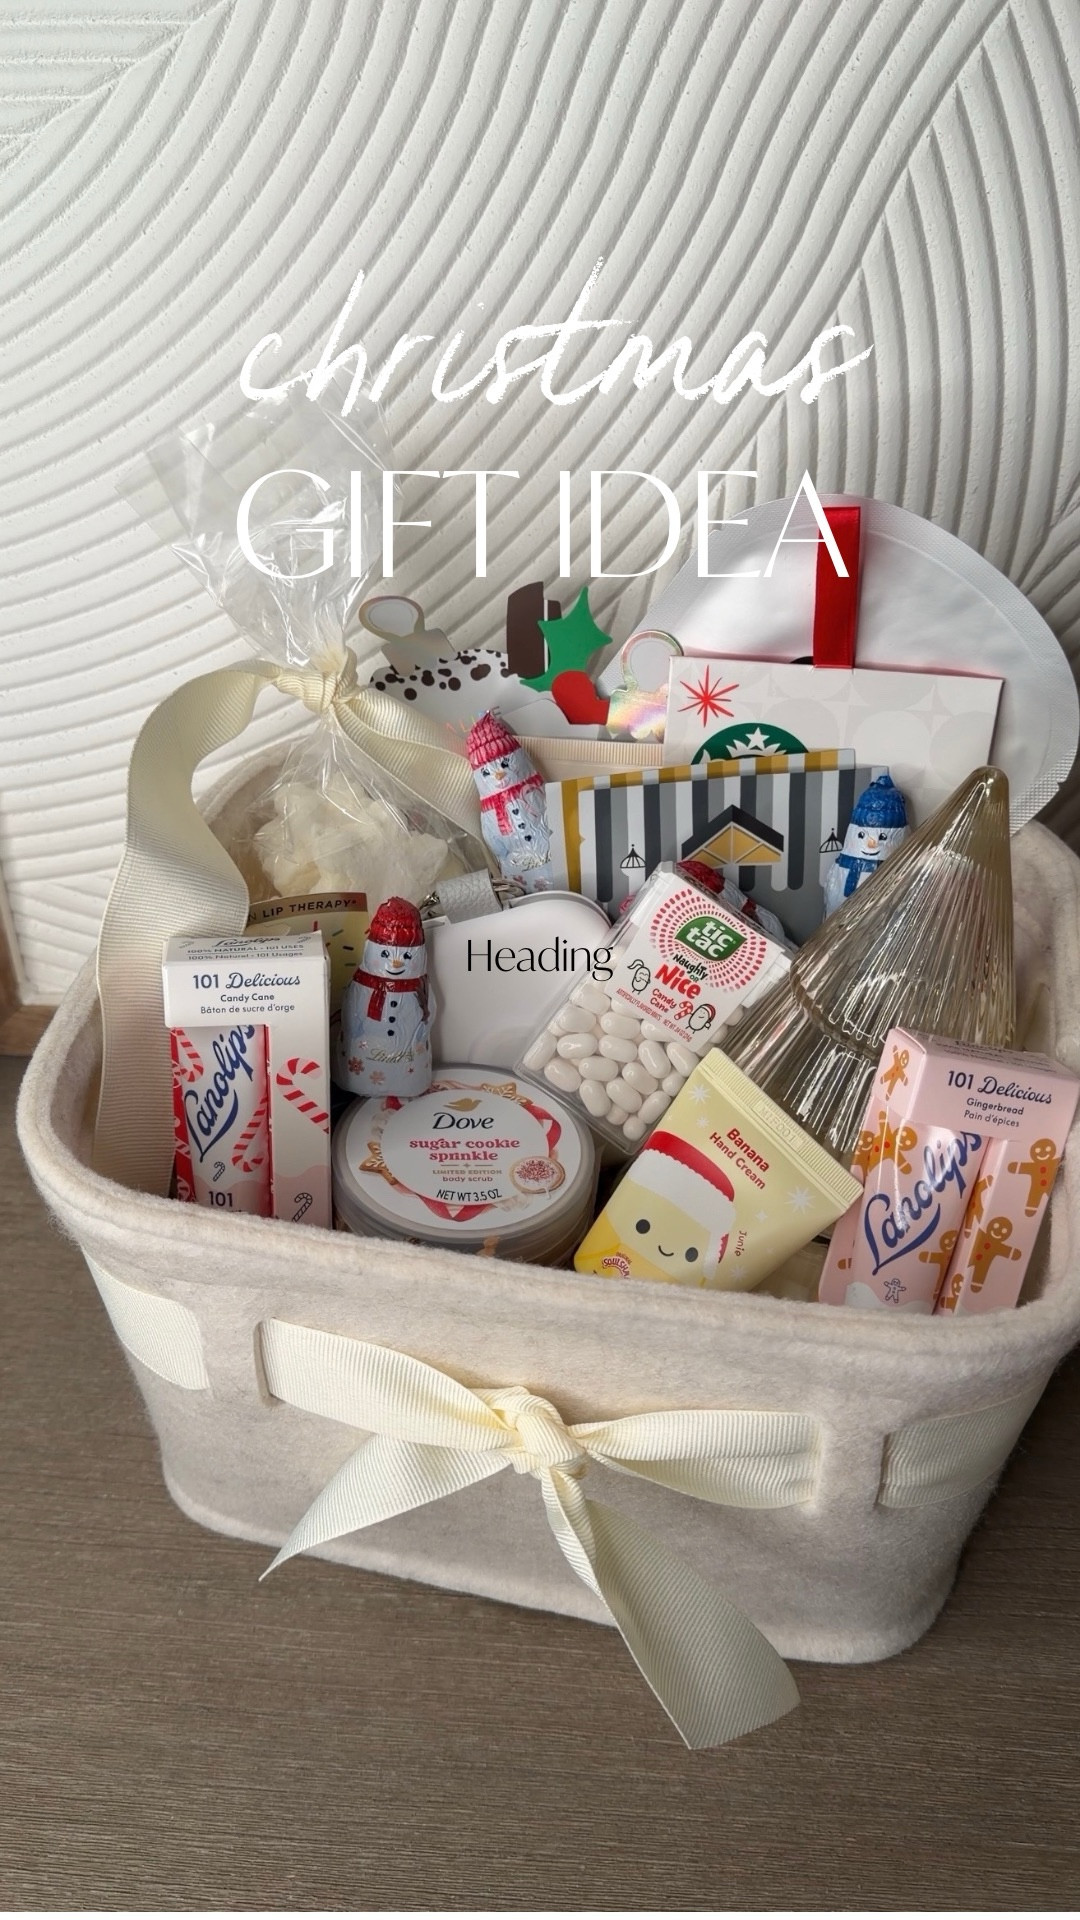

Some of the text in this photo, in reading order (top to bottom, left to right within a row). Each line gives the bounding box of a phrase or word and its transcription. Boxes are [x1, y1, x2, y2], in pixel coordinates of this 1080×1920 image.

[263, 907, 283, 918] LIP
[686, 926, 725, 958] tac
[701, 920, 733, 948] tic
[193, 972, 301, 990] 101 Delicious
[654, 963, 701, 999] Nice
[220, 993, 275, 1003] Candy Cane
[650, 997, 669, 1013] Cane
[652, 988, 677, 1009] Candy
[200, 1003, 295, 1015] Bâton de sucre d'orge
[183, 1024, 256, 1163] Lanolips
[947, 1070, 1052, 1105] 101 Delicious
[966, 1097, 1024, 1116] Gingerbread
[432, 1112, 494, 1130] Dove
[963, 1109, 1020, 1129] Pain d'épices
[409, 1137, 520, 1150] sugar cookie
[726, 1127, 770, 1173] Banana
[429, 1150, 498, 1162] sprinkle
[709, 1131, 767, 1190] Hand Cream
[442, 1175, 493, 1183] body scrub
[208, 1191, 233, 1207] 101
[436, 1188, 502, 1202] NET WT 3.5 OZ
[864, 1131, 982, 1276] Lanolips
[734, 1229, 748, 1257] Junie
